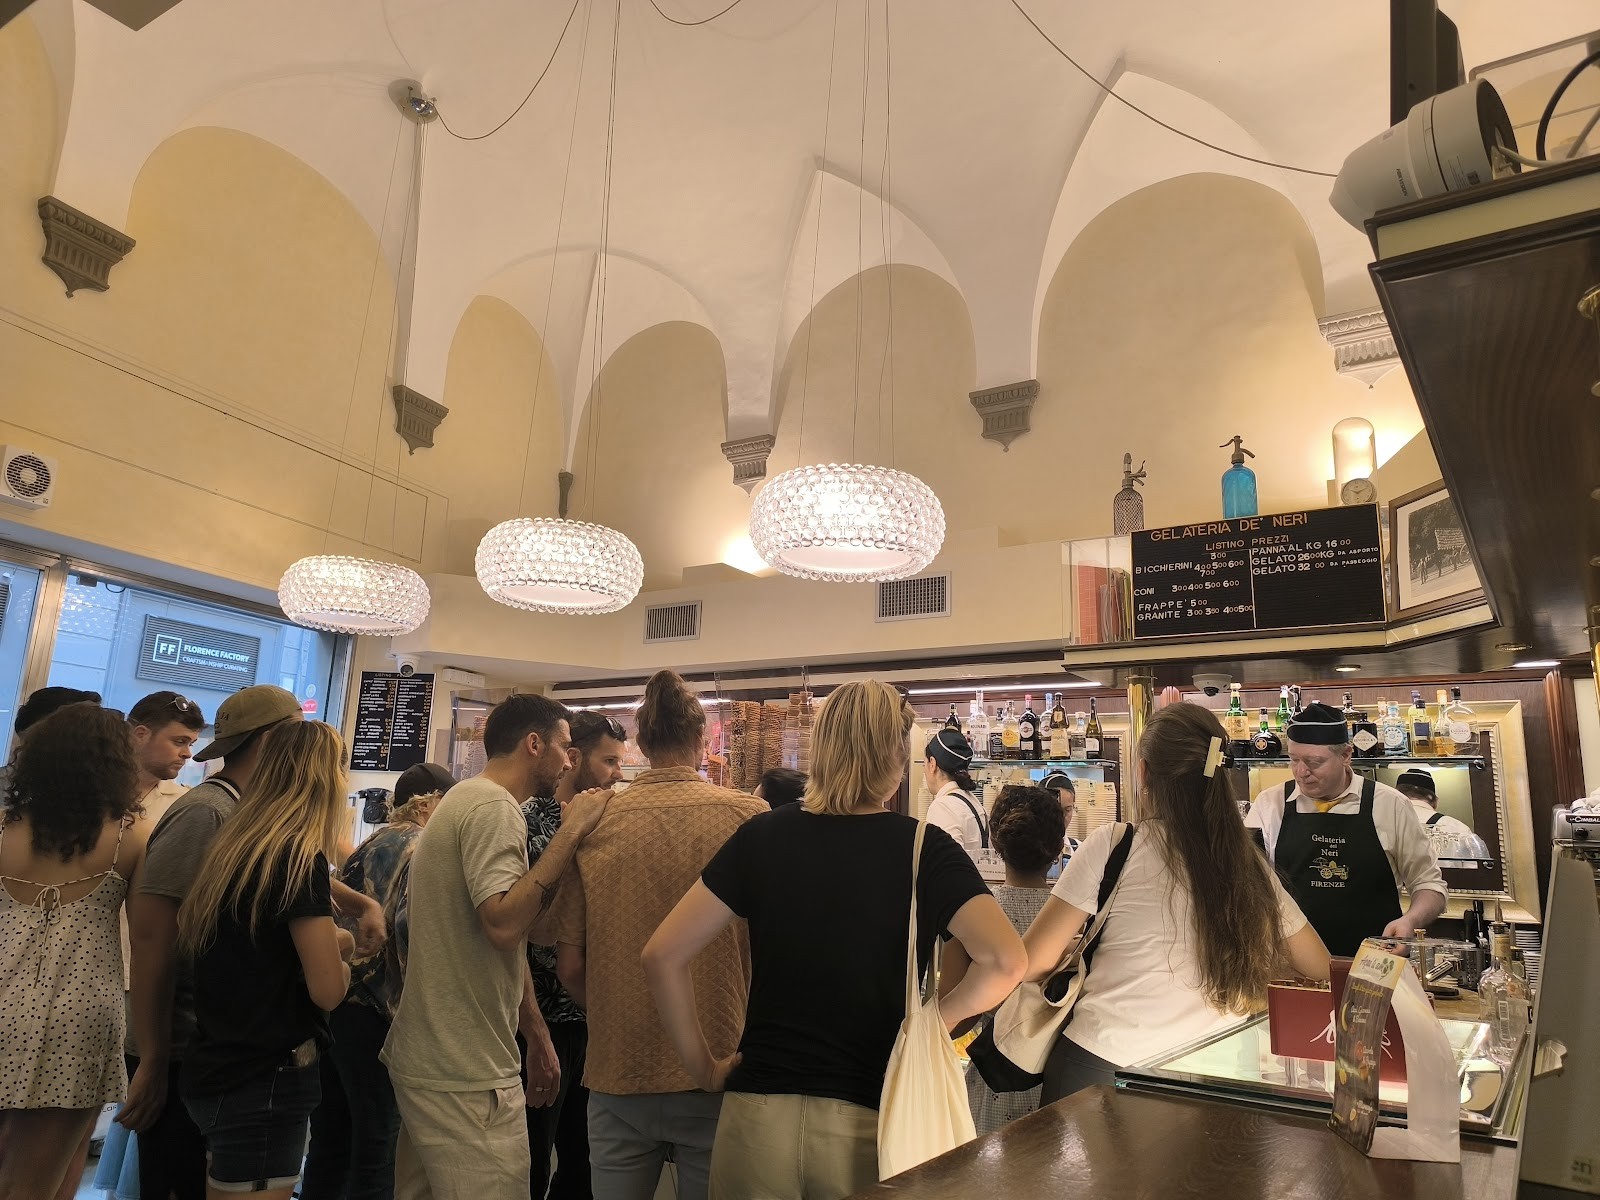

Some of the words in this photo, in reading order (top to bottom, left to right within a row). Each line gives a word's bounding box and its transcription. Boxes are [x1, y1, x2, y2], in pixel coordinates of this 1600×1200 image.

[1150, 523, 1231, 541] GELATERIA
[1239, 518, 1264, 531] DE'
[1273, 513, 1308, 527] NERI
[1205, 540, 1245, 551] LISTINO
[1251, 535, 1289, 546] PREZZI
[1252, 545, 1286, 556] PANNA
[1287, 544, 1302, 552] AL
[1306, 542, 1322, 550] KG
[1251, 555, 1296, 566] GELATO
[1349, 547, 1379, 555] ASPORTO
[1135, 562, 1193, 574] BICCHIERINI
[1252, 564, 1296, 575] GELATO
[1341, 558, 1378, 566] PASSEGGIO
[1134, 588, 1155, 596] CONI
[1137, 611, 1181, 621] GRANITE
[160, 643, 176, 655] FF
[184, 645, 219, 657] FLORENCE
[220, 651, 249, 662] FACTORY
[223, 663, 248, 672] CURATING
[1311, 834, 1346, 844] Gelateria
[1321, 848, 1339, 857] Neri
